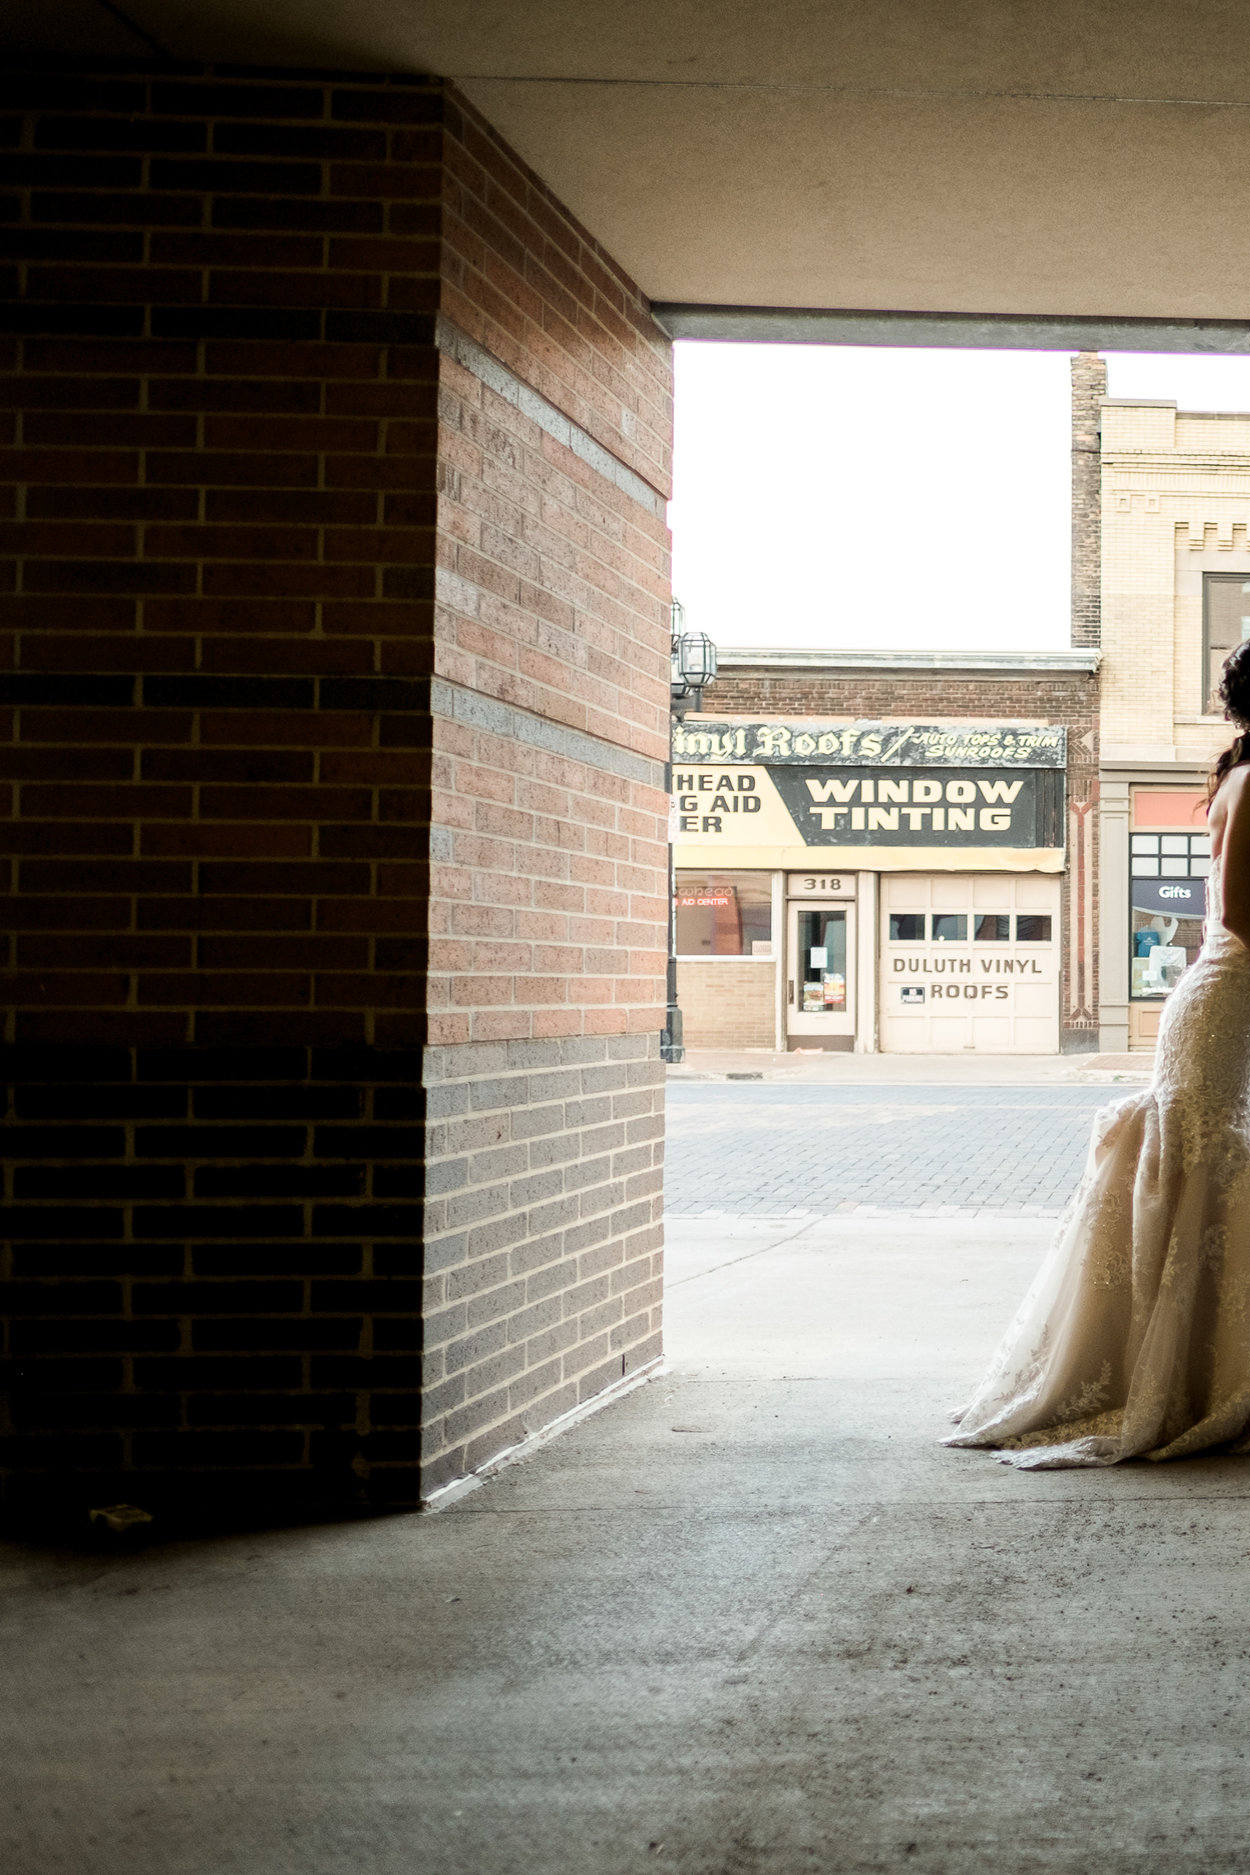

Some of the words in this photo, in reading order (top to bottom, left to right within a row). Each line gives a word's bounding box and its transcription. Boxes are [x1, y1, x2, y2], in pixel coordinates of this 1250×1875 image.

[673, 725, 747, 761] inyl
[753, 725, 883, 758] Roofs
[912, 732, 956, 746] AUTO
[963, 733, 1000, 746] TOPS
[1003, 734, 1016, 746] &
[1015, 734, 1060, 748] TRIM
[924, 745, 1032, 759] SUNROOFS
[672, 774, 756, 792] HEAD
[804, 779, 1025, 804] WINDOW
[709, 795, 761, 813] AID
[809, 806, 1012, 831] TINTING
[803, 878, 842, 890] 318
[1158, 885, 1192, 899] Gifts
[681, 897, 696, 906] AID
[697, 897, 729, 906] CENTER
[893, 958, 972, 973] DULUTH
[980, 958, 1043, 974] VINYL
[930, 984, 1009, 999] ROOFS
